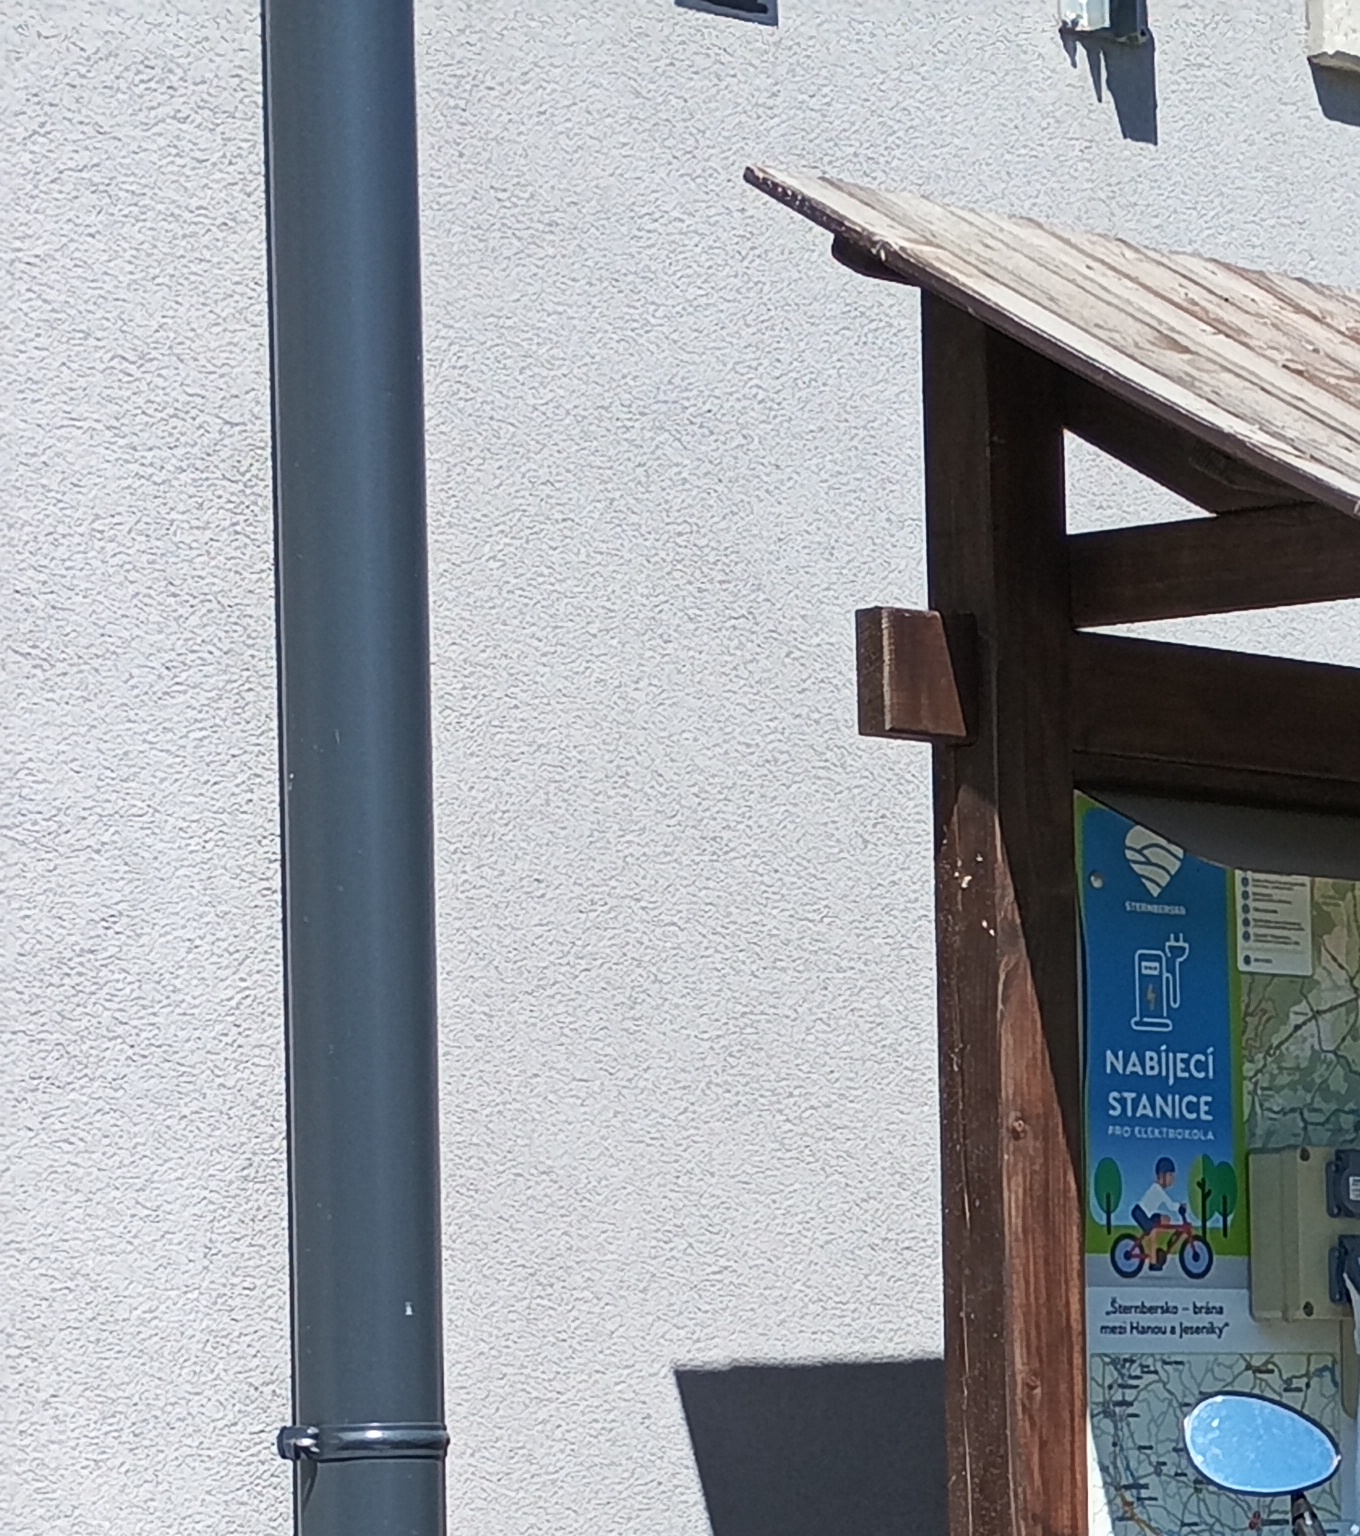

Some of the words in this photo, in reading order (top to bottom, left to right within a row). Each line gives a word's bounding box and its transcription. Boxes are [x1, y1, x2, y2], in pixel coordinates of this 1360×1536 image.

[1105, 1044, 1214, 1087] NABÍJECÍ
[1108, 1091, 1214, 1121] STANICE
[1108, 1125, 1132, 1138] PRO
[1134, 1126, 1215, 1141] ELEKTROKOLA
[1101, 1321, 1127, 1335] mezi
